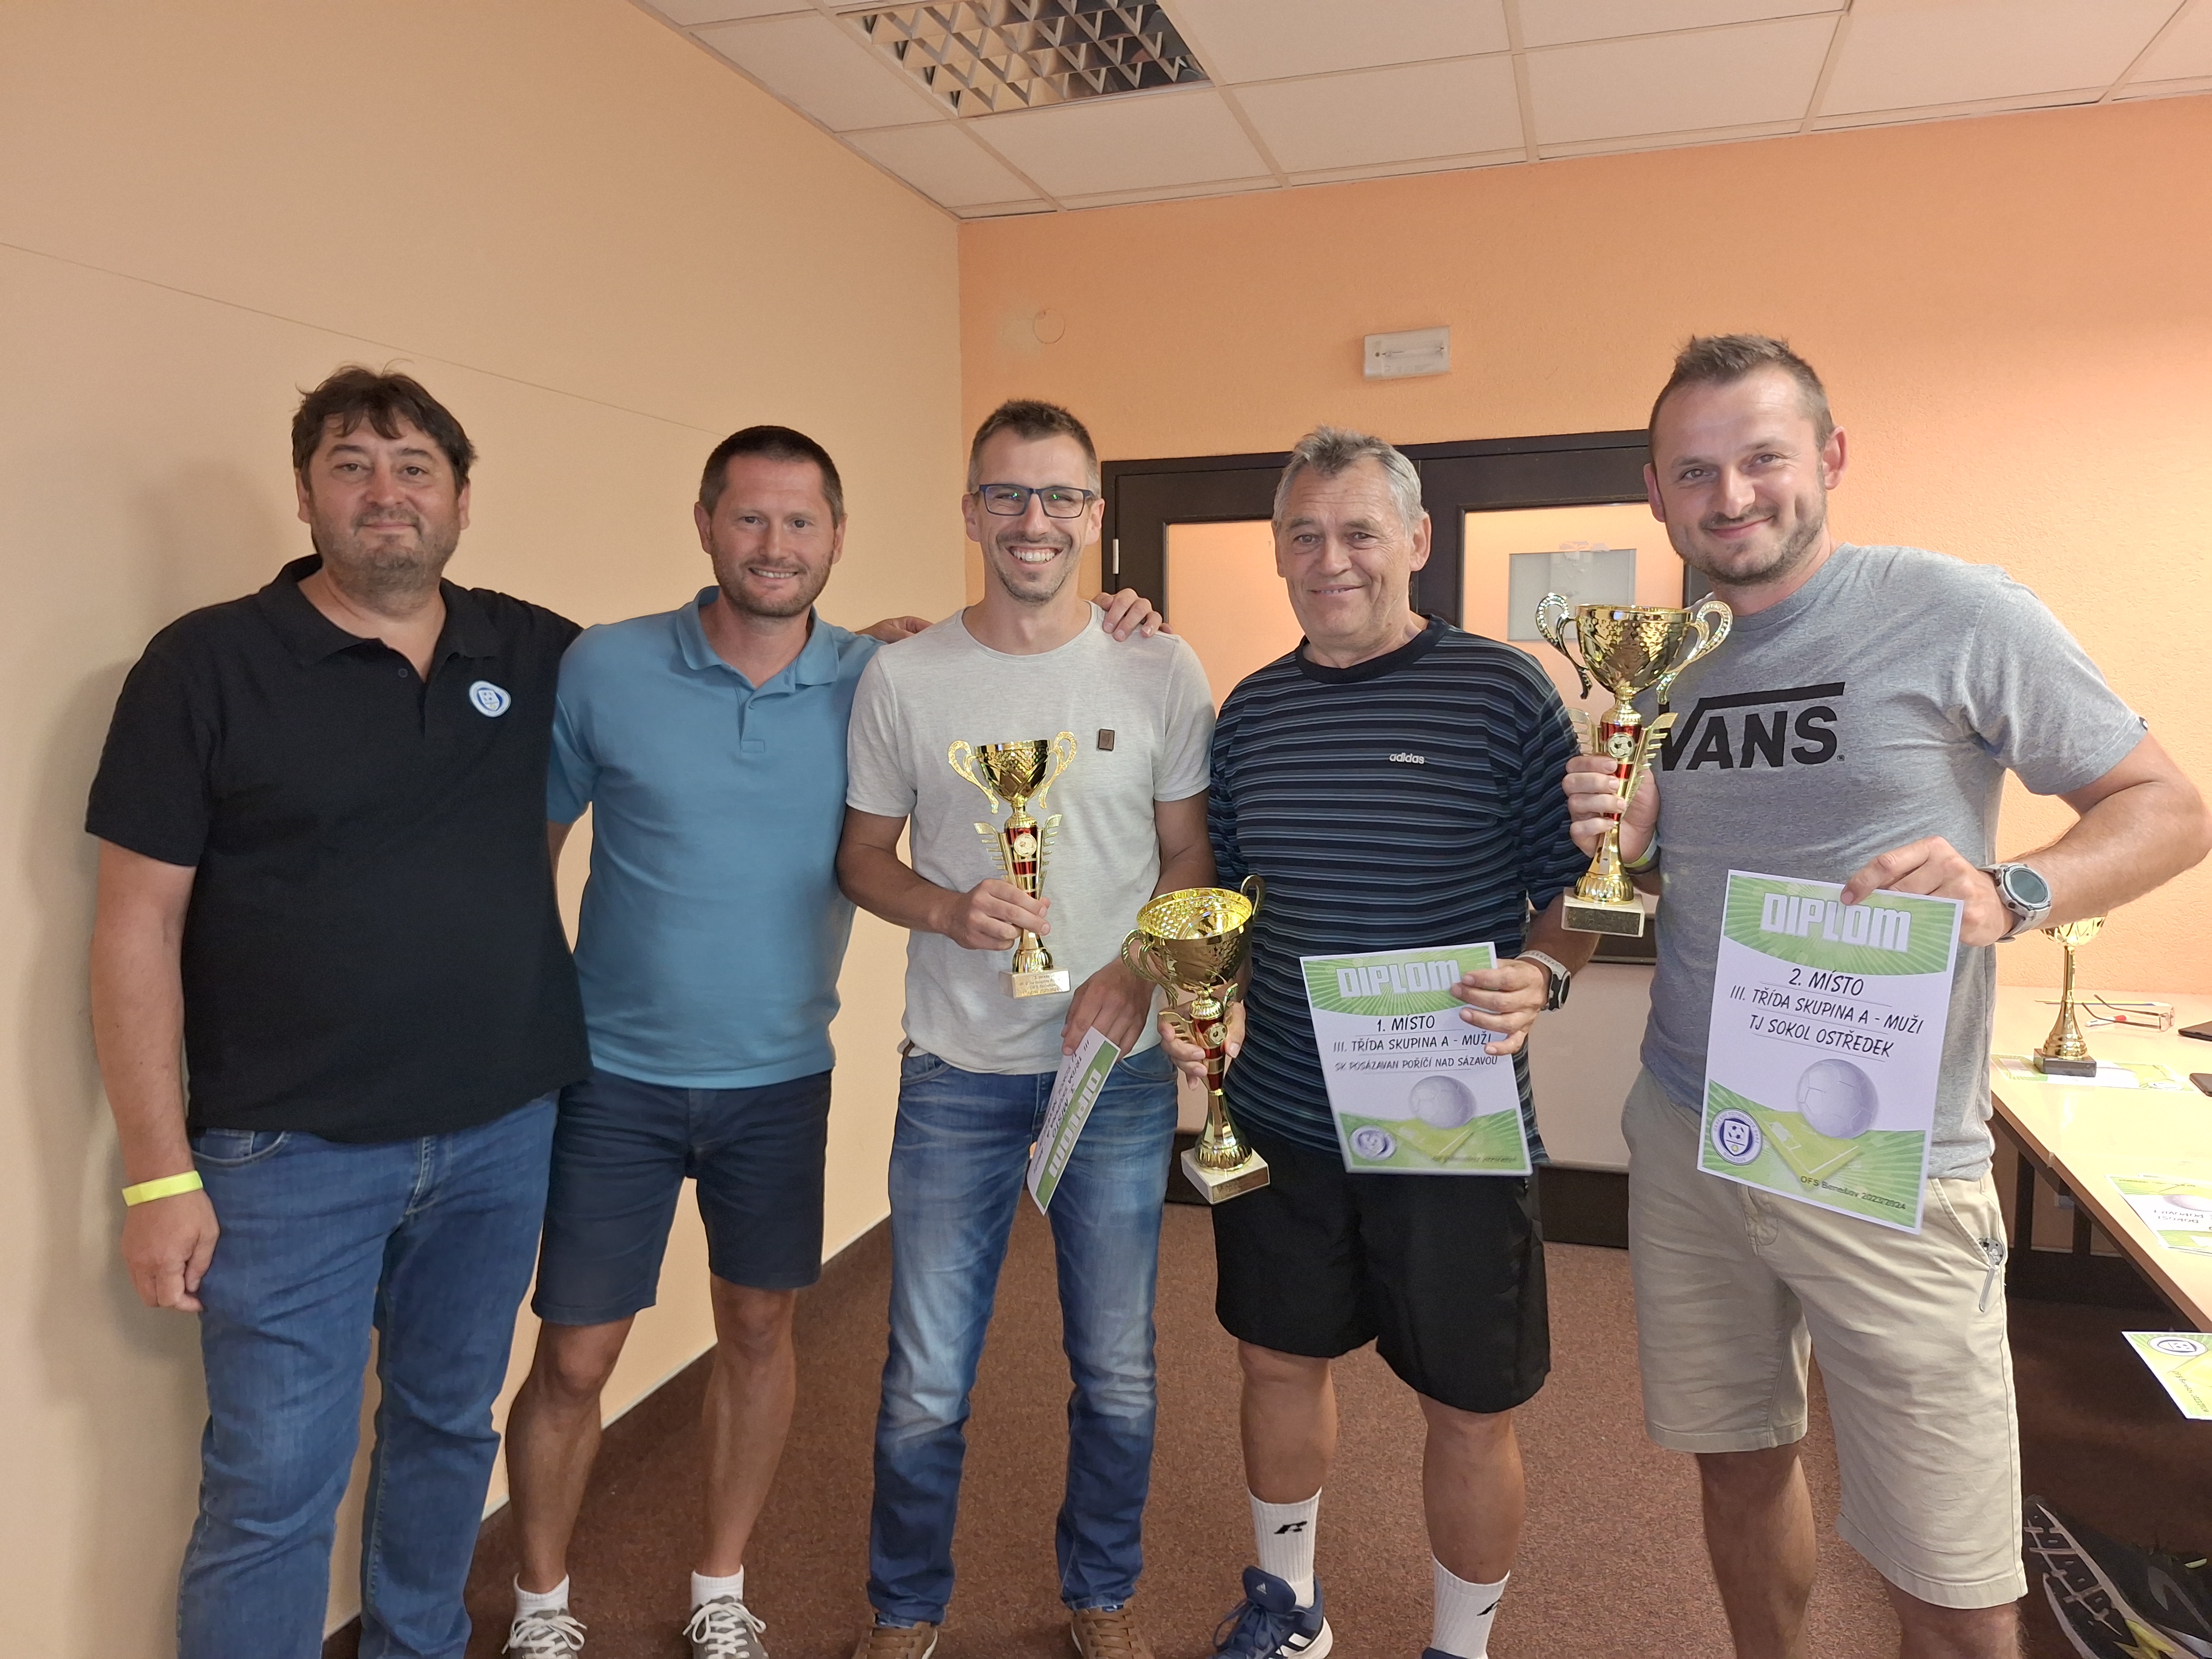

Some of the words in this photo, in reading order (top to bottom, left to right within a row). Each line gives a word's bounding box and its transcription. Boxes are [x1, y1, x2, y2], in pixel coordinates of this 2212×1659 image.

[1658, 682, 1845, 771] VANS
[1389, 753, 1425, 764] adidas
[1761, 892, 1912, 953] DIPLOM
[1336, 960, 1462, 998] DIPLOM
[1788, 968, 1801, 986] 2.
[1808, 969, 1864, 996] MÍSTO
[1377, 1019, 1386, 1032] 1.
[1391, 1014, 1435, 1031] MÍSTO
[1730, 985, 1745, 1001] III.
[1752, 987, 1790, 1009] TŘÍDA
[1795, 998, 1854, 1021] SKUPINA
[1857, 1009, 1868, 1024] A
[1883, 1014, 1924, 1034] MUŽI
[1352, 1038, 1384, 1052] TŘÍDA
[1389, 1036, 1437, 1050] SKUPINA
[1441, 1036, 1449, 1047] A
[1462, 1031, 1491, 1046] MUŽI
[1750, 1014, 1764, 1030] TJ
[1767, 1019, 1810, 1040] SOKOL
[1816, 1029, 1894, 1057] OSTŘEDEK
[1403, 1056, 1431, 1069] POŘÍČÍ
[1436, 1058, 1454, 1068] NAD
[1458, 1055, 1497, 1066] SÁZAVOU
[1048, 1068, 1102, 1178] DIPLOM
[1800, 1176, 1819, 1187] OFS
